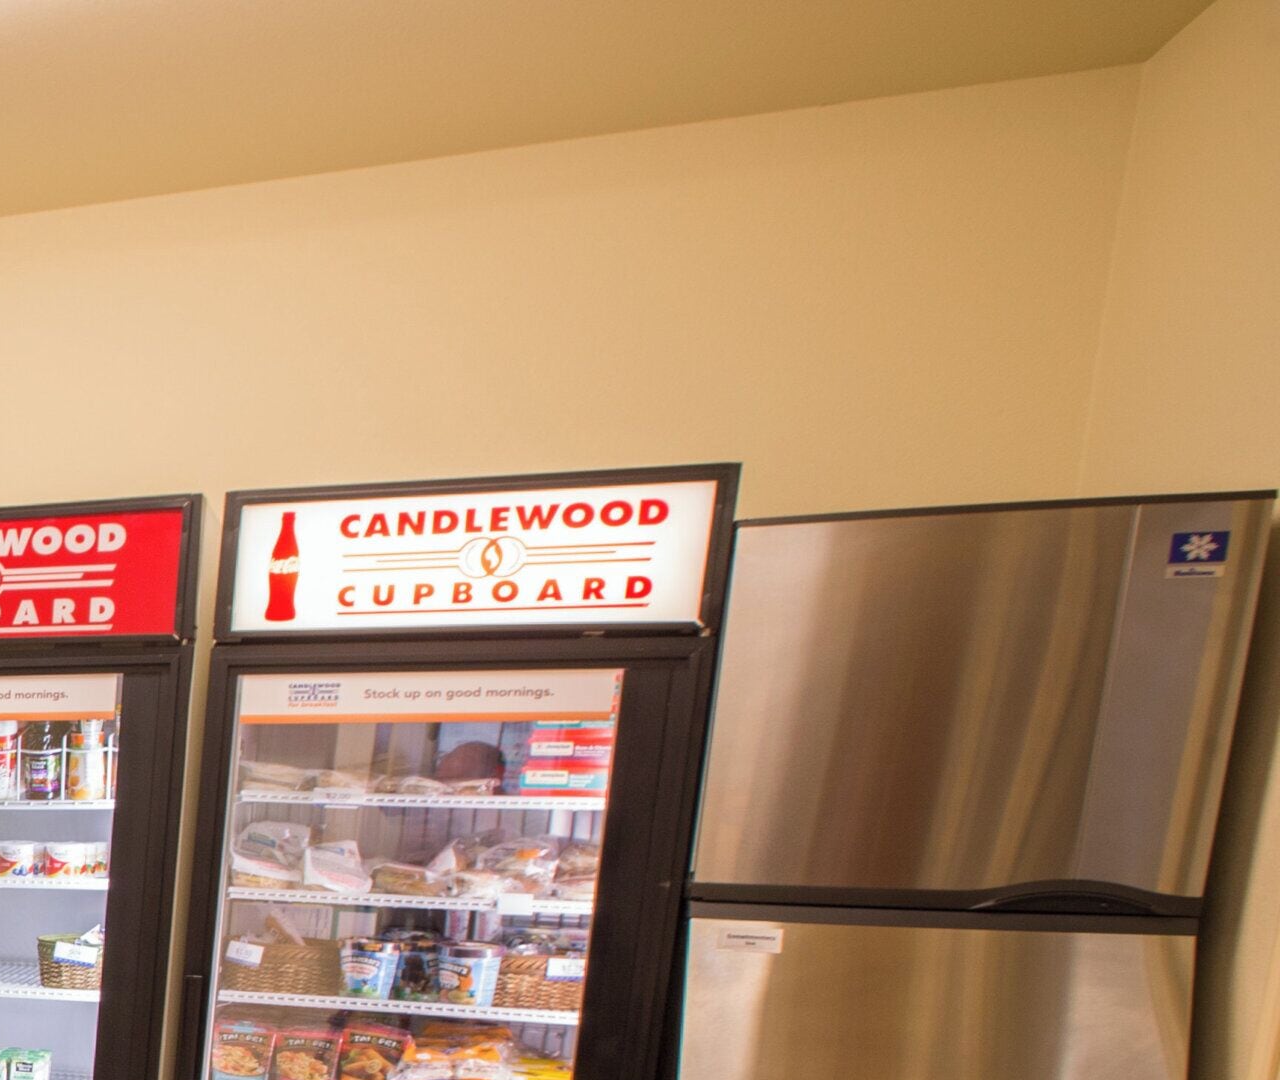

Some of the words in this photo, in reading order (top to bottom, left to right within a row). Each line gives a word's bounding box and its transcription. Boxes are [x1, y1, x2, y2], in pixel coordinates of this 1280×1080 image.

[339, 498, 670, 540] CANDLEWOOD
[337, 575, 654, 608] CUPBOARD
[14, 690, 70, 702] mornings.
[363, 687, 400, 700] Stock
[404, 689, 421, 702] up
[425, 688, 443, 699] on
[446, 686, 482, 702] good
[486, 685, 555, 701] mornings.
[221, 1032, 240, 1042] TAI
[287, 1037, 307, 1047] TAI
[350, 1034, 372, 1045] TAI
